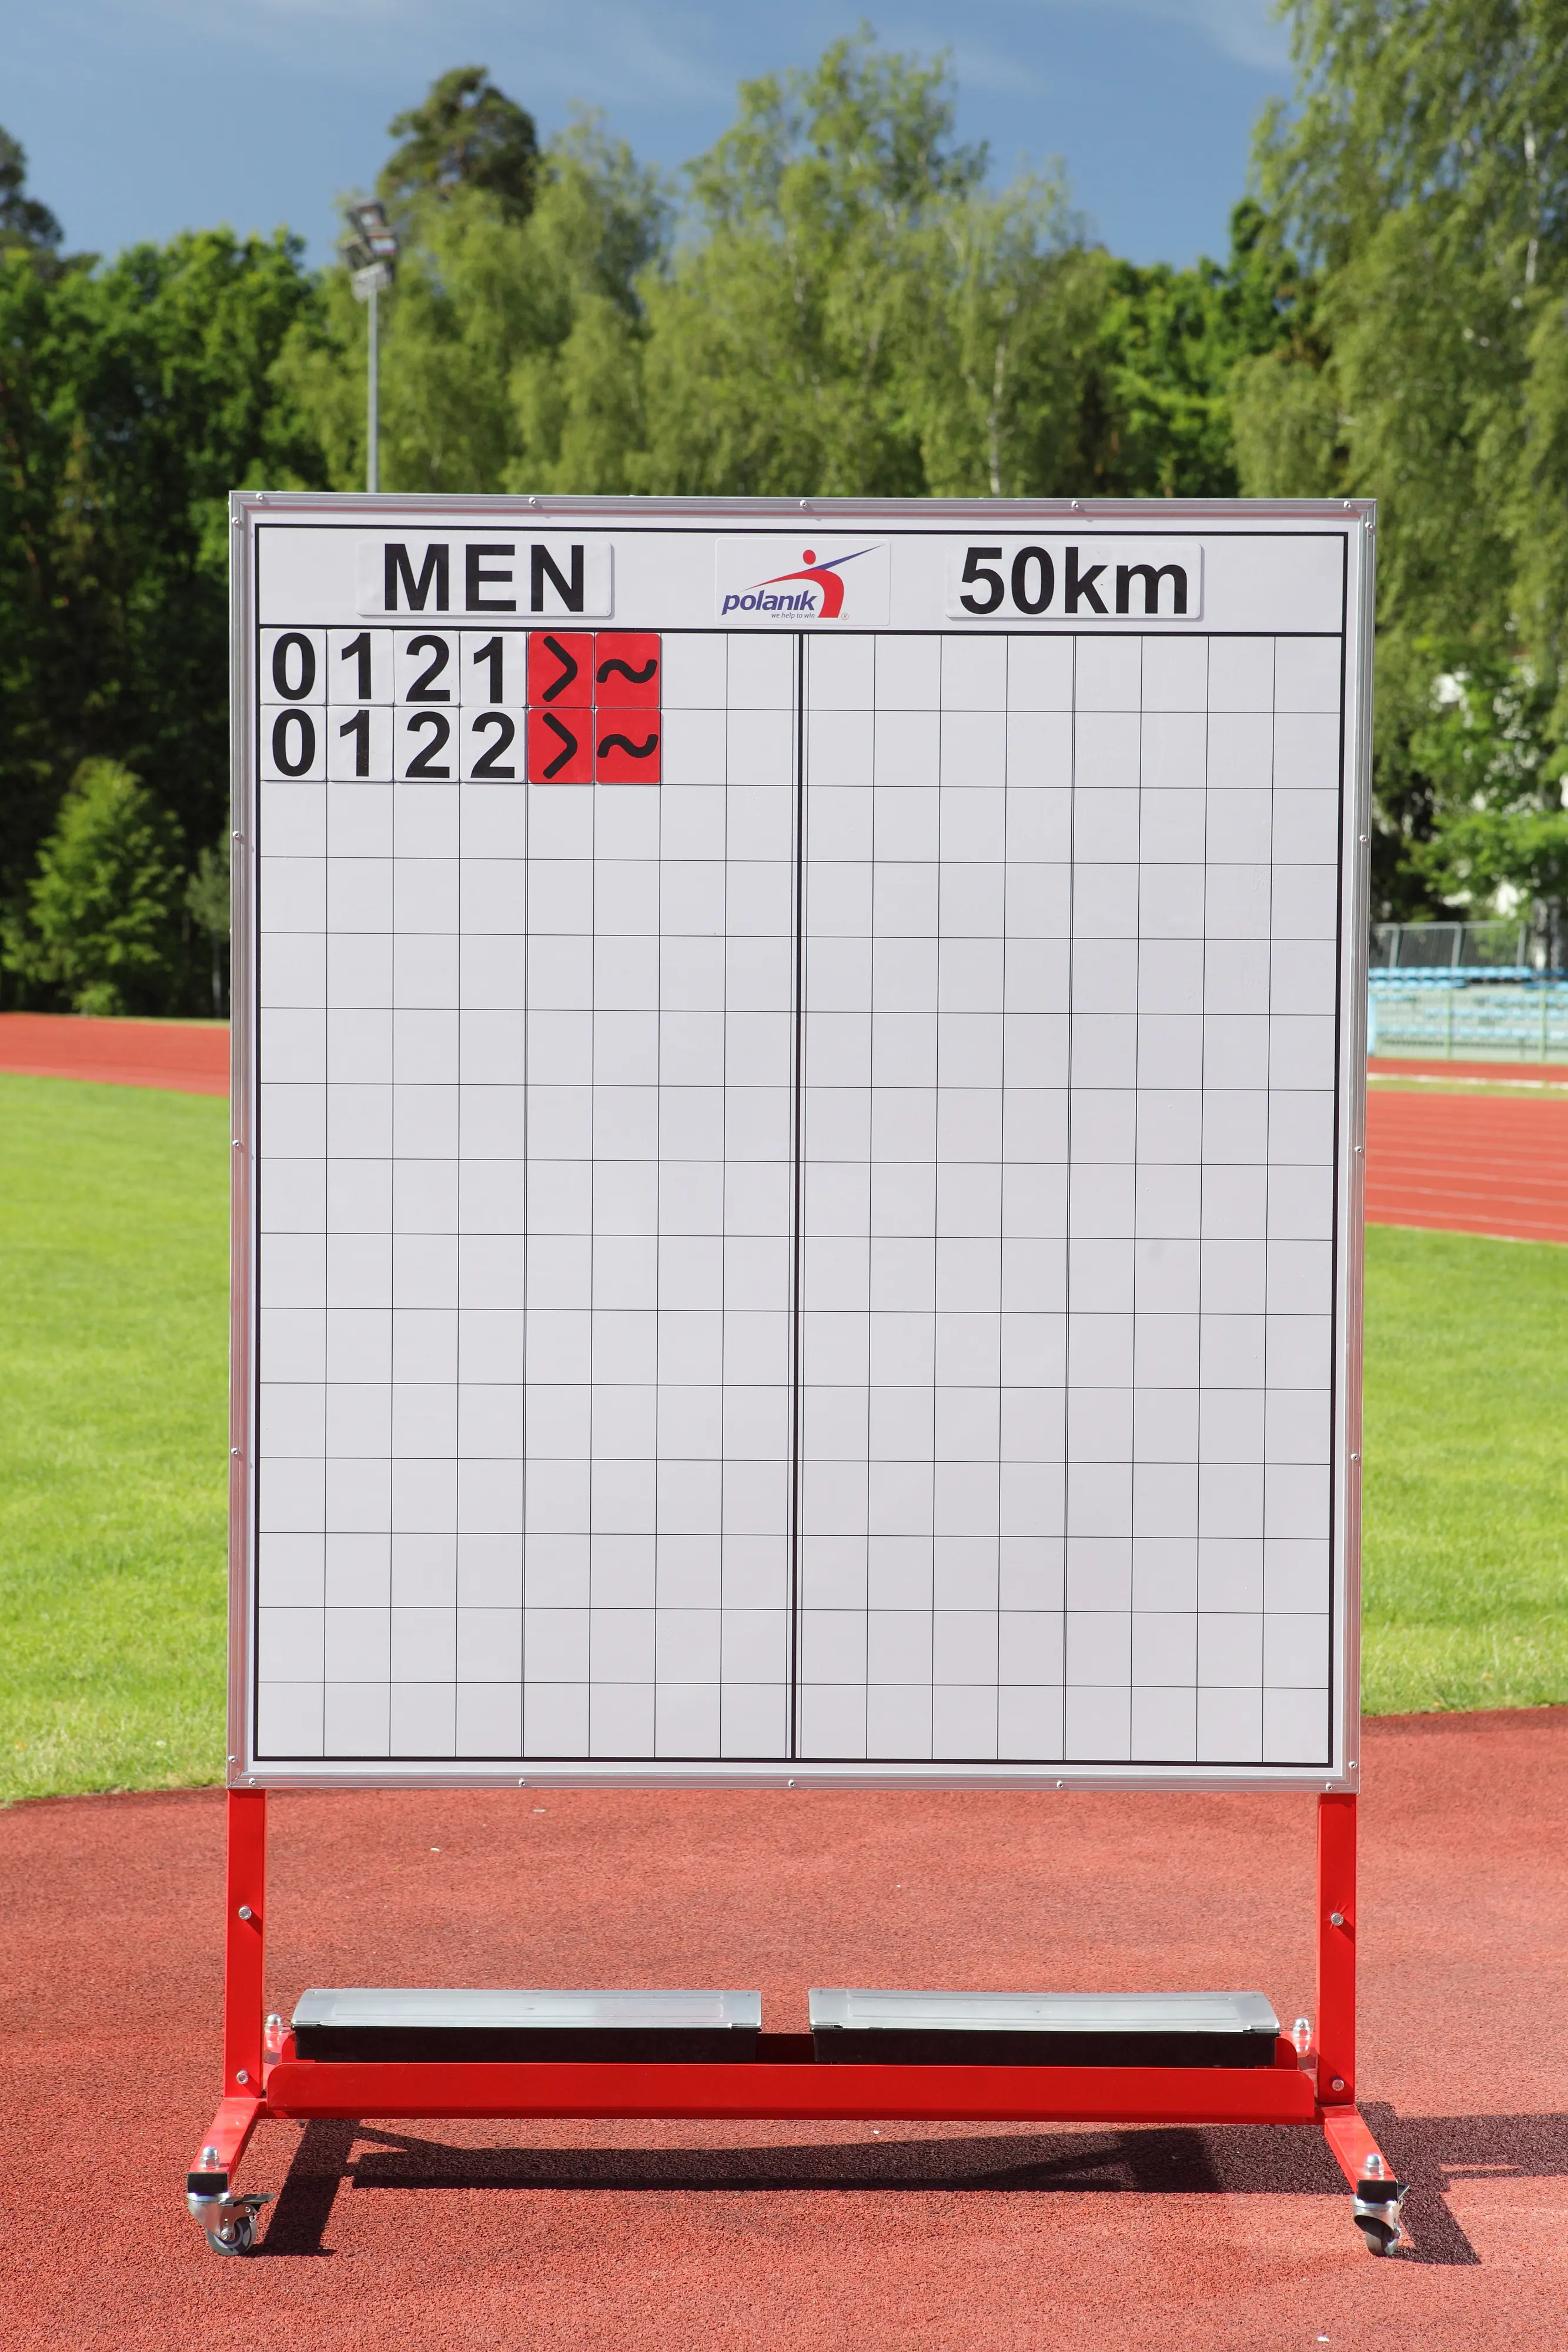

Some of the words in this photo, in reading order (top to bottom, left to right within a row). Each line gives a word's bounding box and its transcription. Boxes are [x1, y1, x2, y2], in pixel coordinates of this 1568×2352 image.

[384, 543, 584, 612] MEN
[721, 589, 818, 616] polanik
[959, 546, 1188, 615] 50km
[272, 632, 504, 704] 0121
[272, 708, 516, 779] 0122
